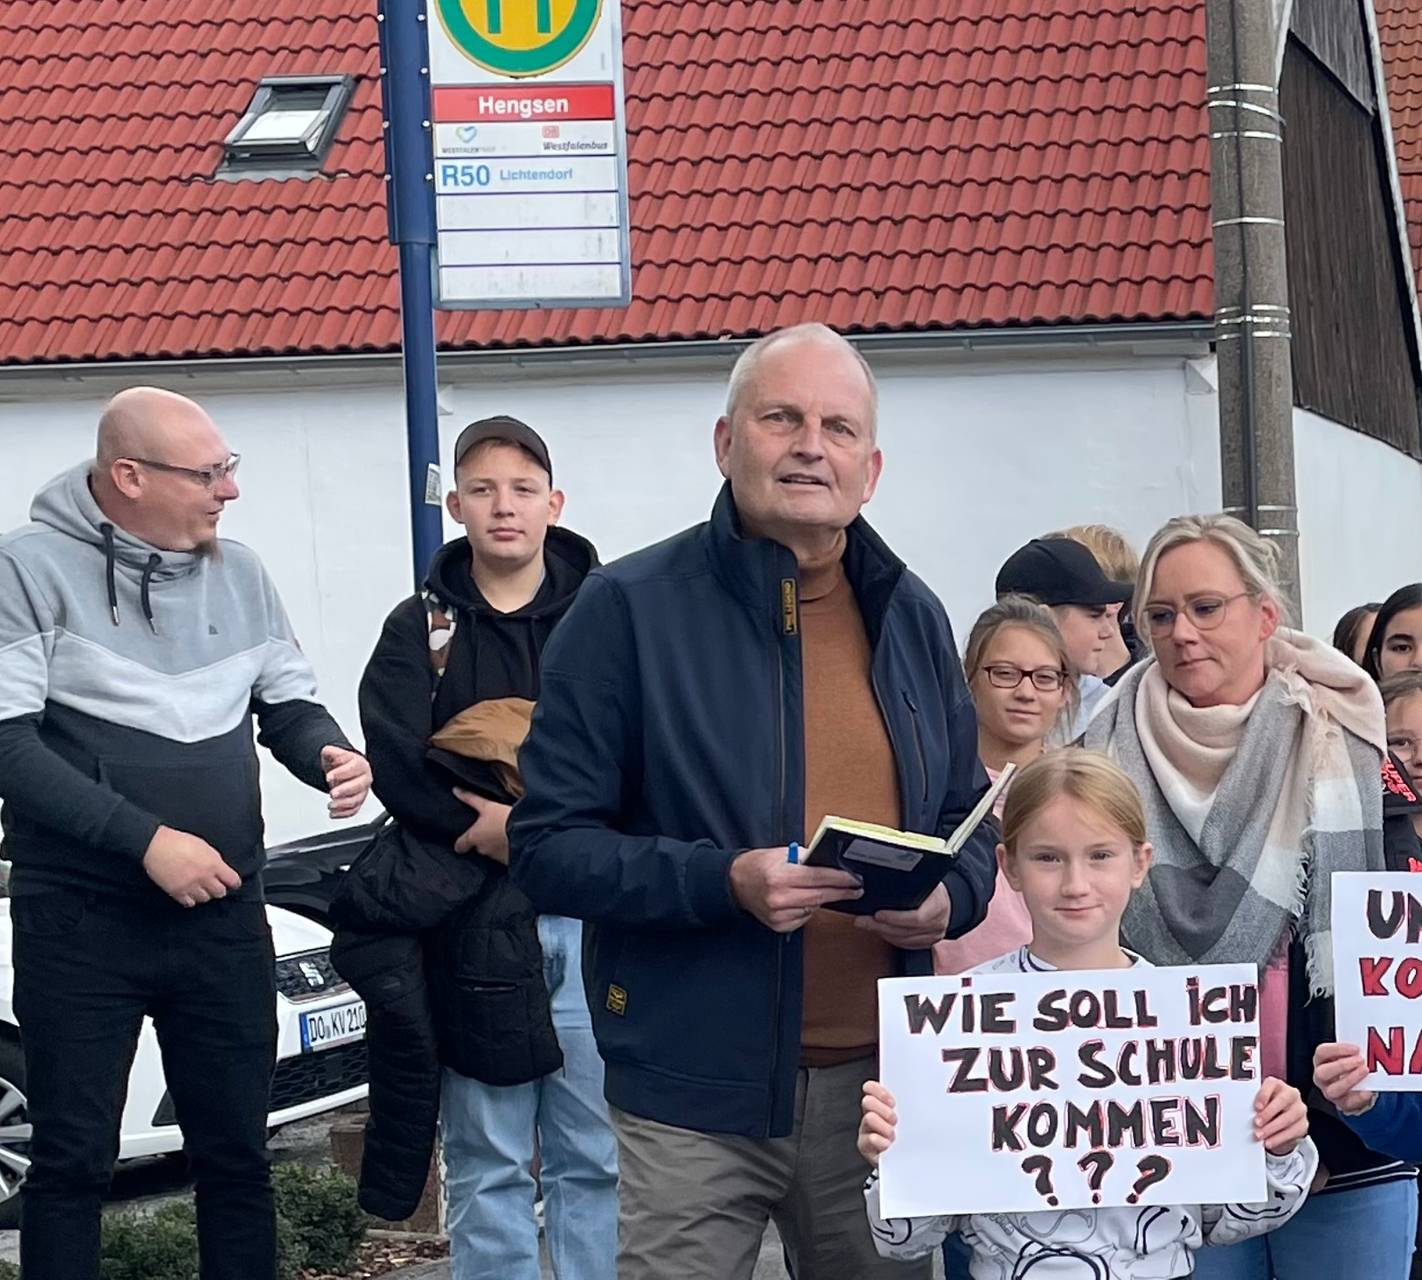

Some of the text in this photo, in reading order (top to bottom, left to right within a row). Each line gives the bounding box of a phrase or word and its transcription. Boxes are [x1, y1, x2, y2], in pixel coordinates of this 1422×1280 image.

[478, 96, 569, 118] Hengsen
[441, 165, 573, 186] R50 Lichtendorf
[1032, 988, 1158, 1034] SOLL
[942, 1035, 1257, 1094] ZUR SCHULE
[991, 1094, 1222, 1153] KOMMEN
